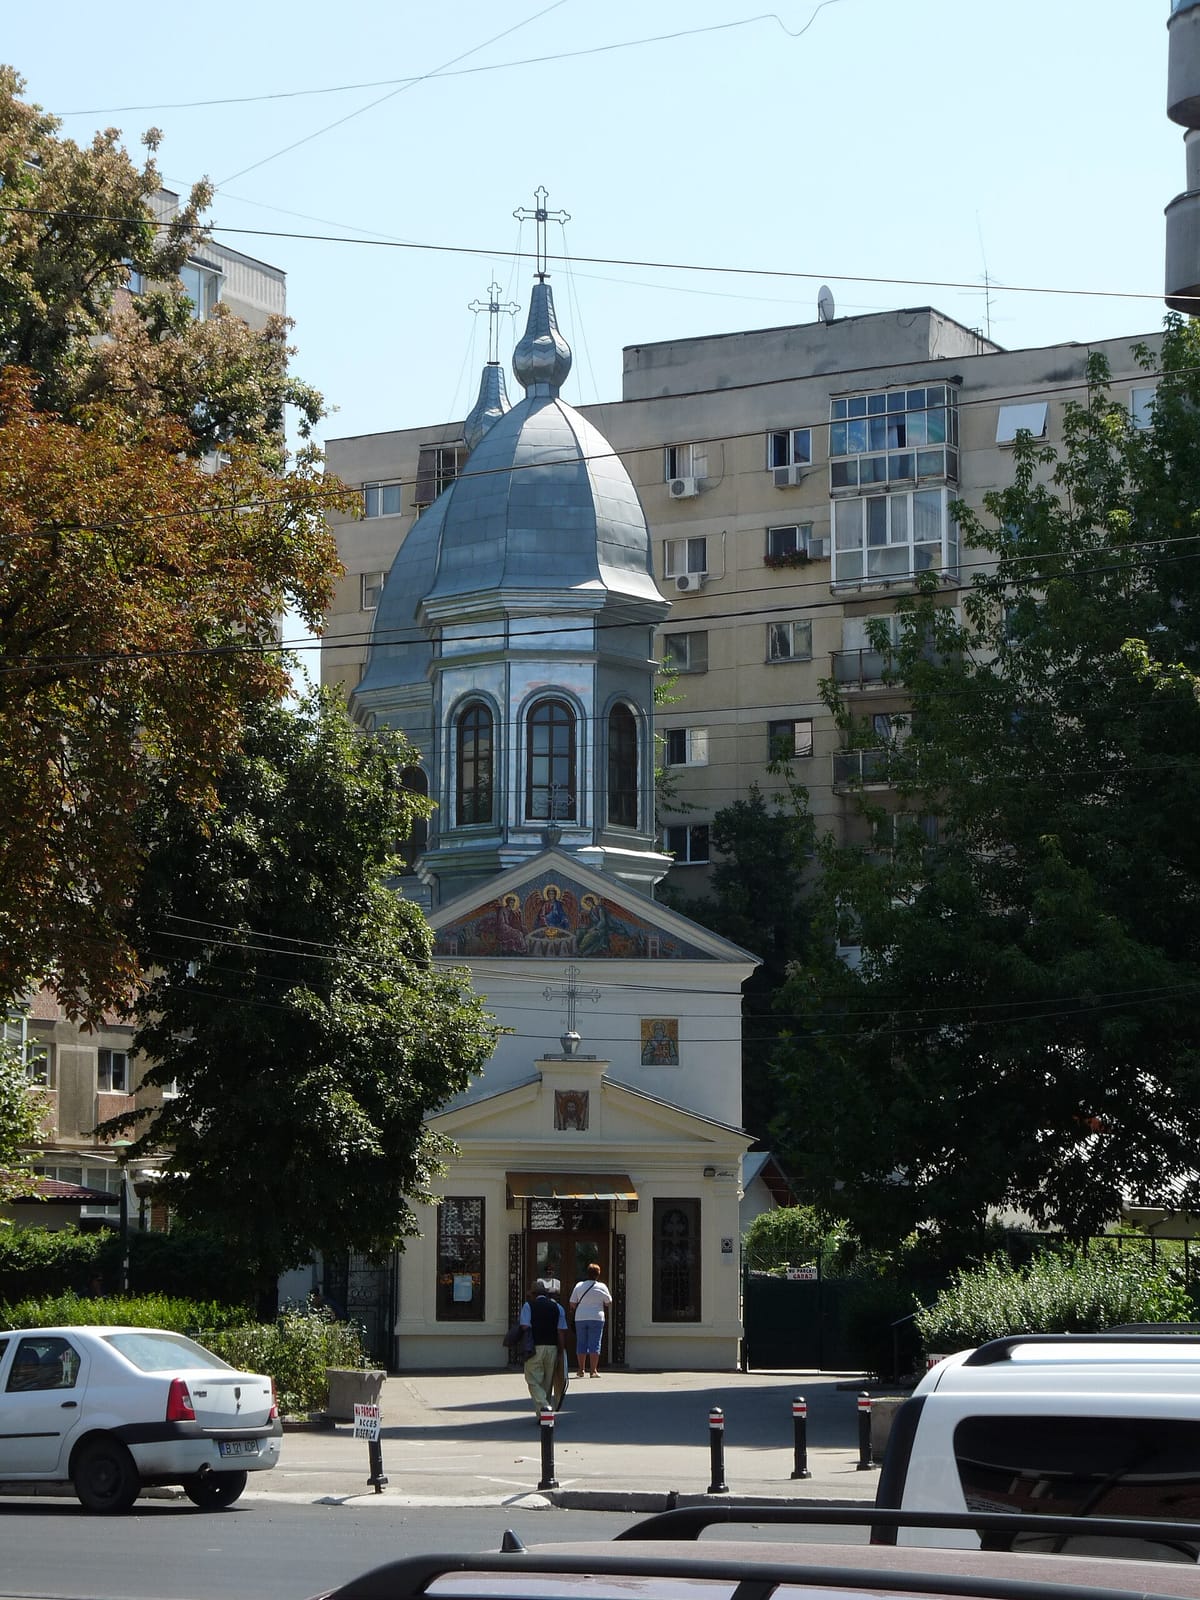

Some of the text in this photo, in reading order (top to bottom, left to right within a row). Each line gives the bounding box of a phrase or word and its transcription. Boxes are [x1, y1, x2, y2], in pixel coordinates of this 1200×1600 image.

[354, 1406, 361, 1416] NU
[359, 1418, 377, 1428] ACCES
[354, 1428, 377, 1440] BISERICA
[226, 1443, 231, 1454] B
